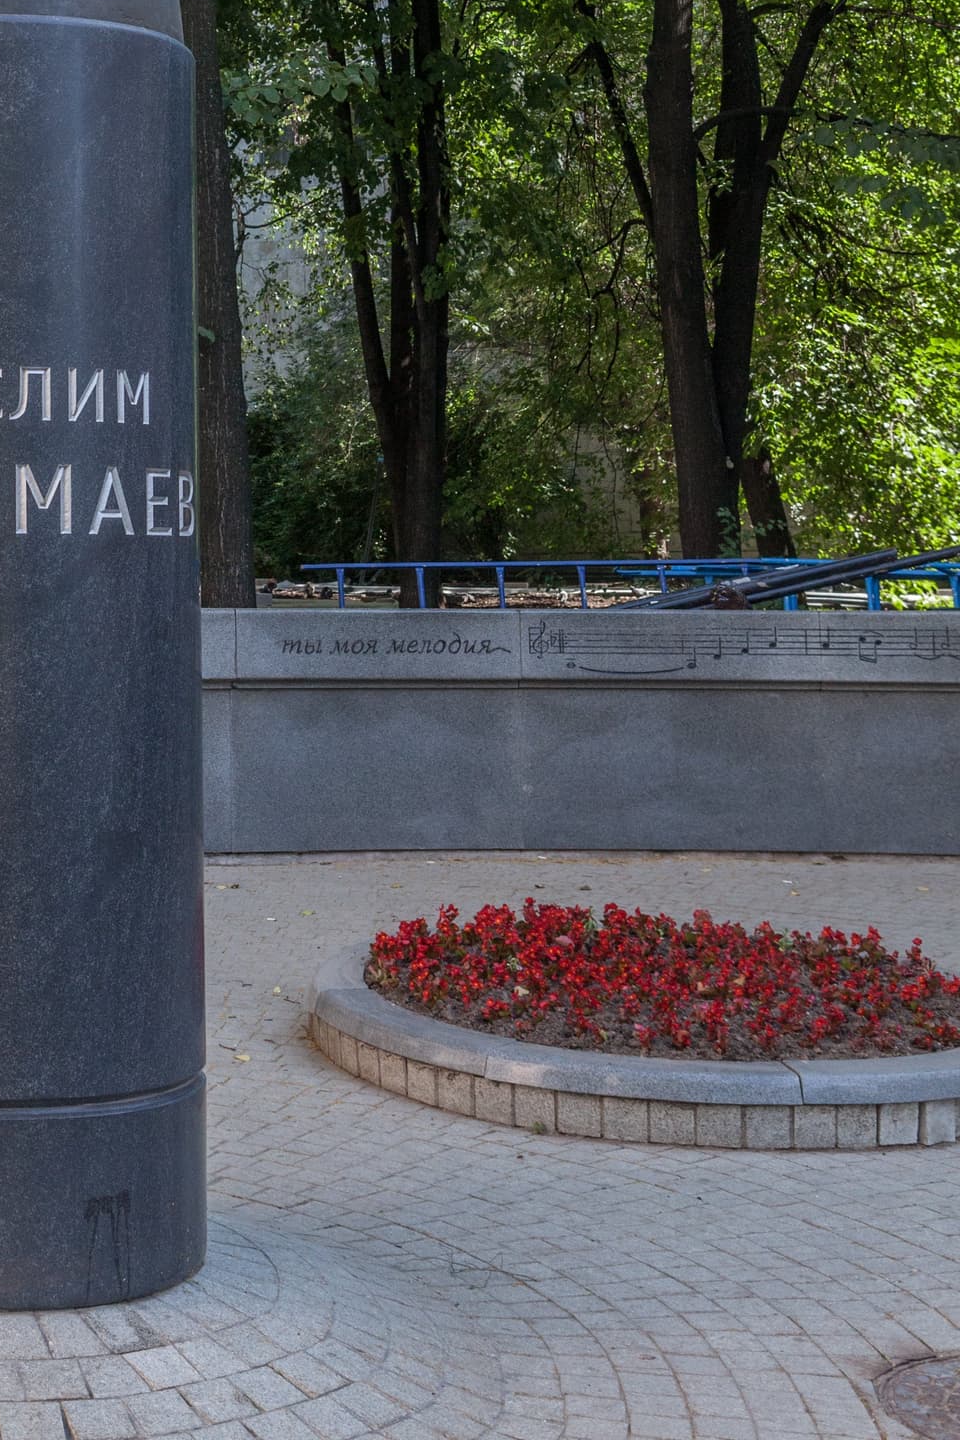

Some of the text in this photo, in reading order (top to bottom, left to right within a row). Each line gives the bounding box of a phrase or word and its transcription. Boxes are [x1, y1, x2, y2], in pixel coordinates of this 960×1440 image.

[282, 631, 510, 656] ты моя мелодия
